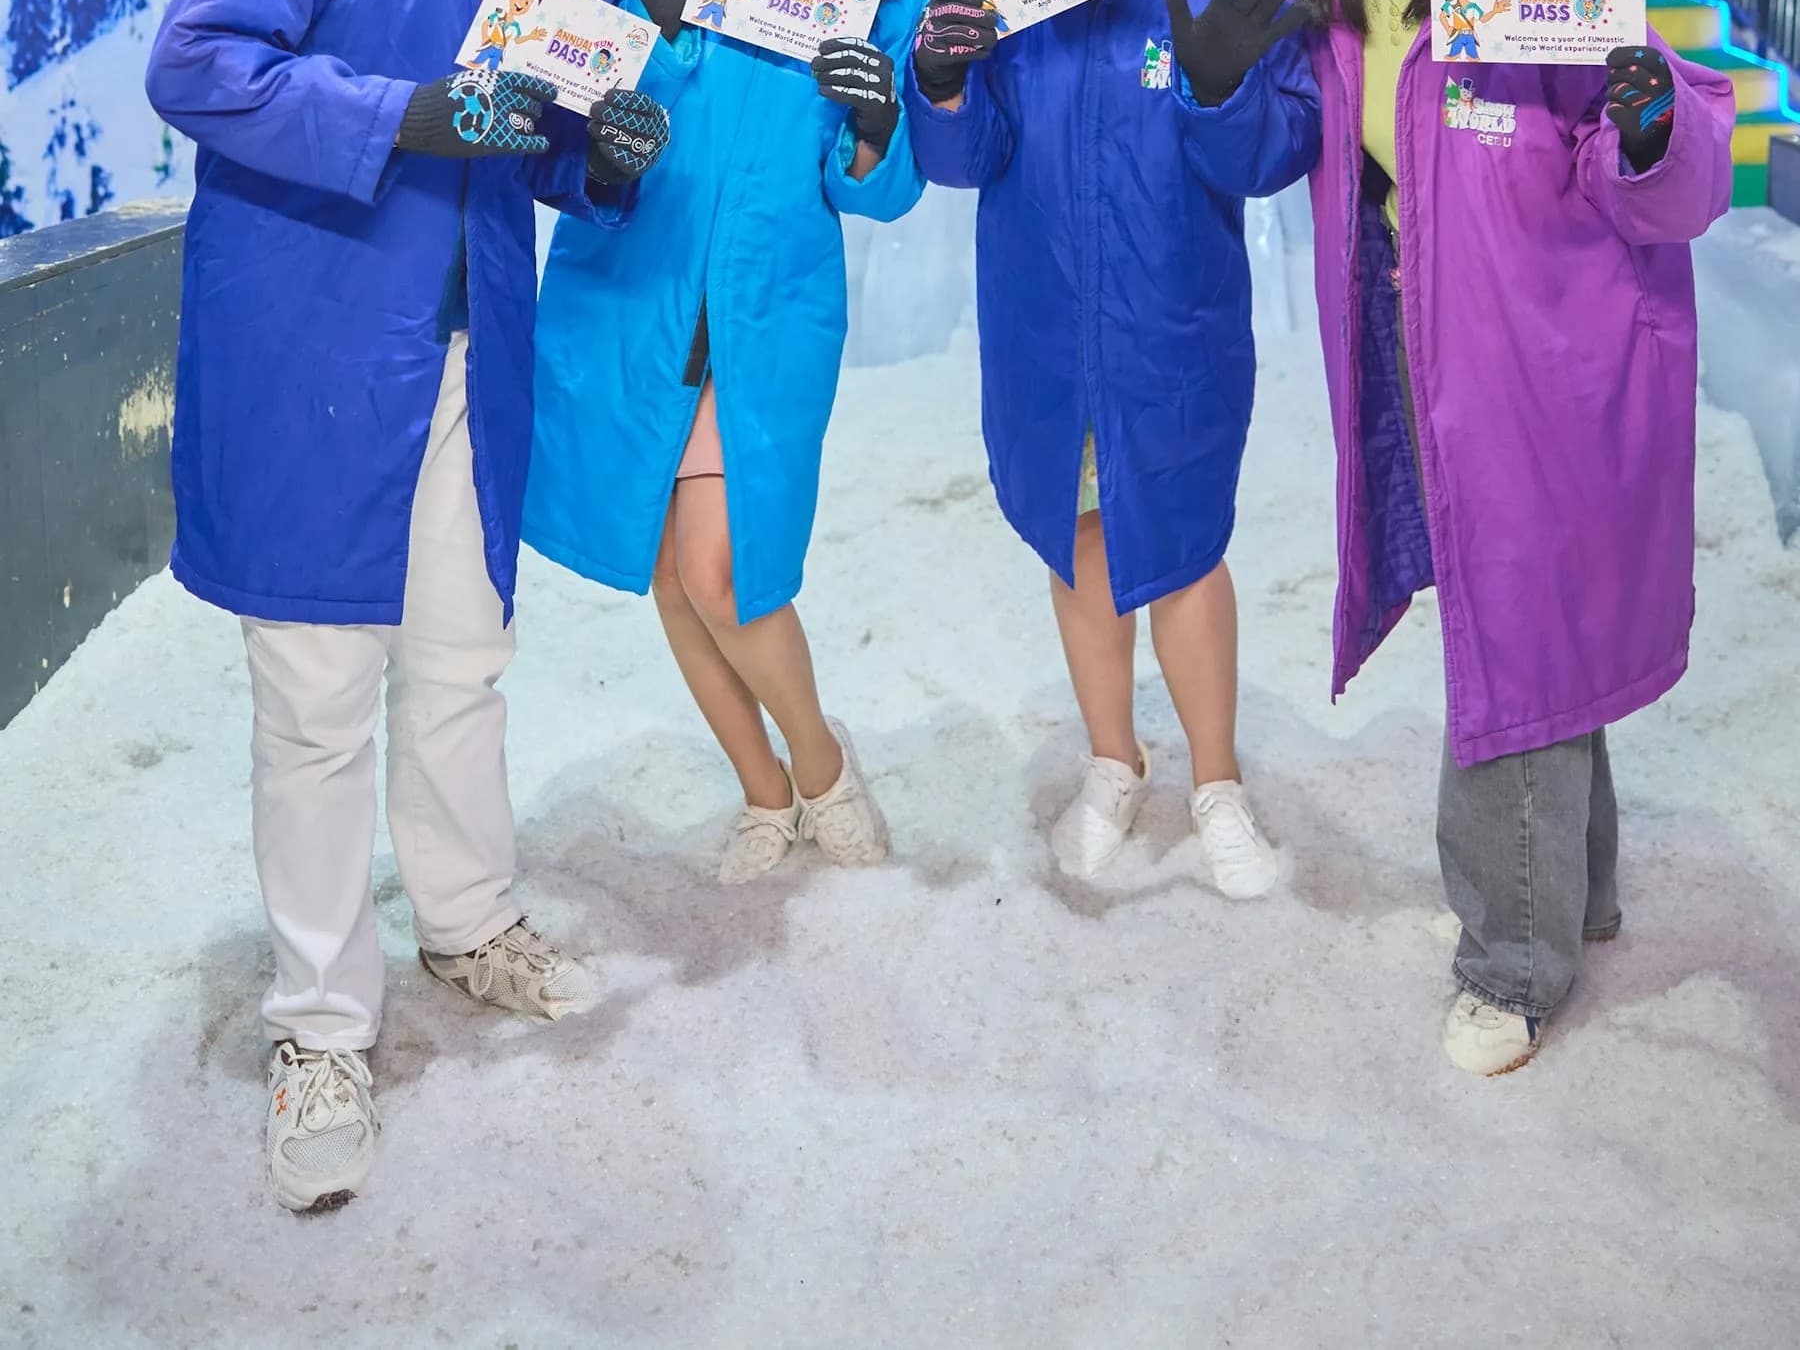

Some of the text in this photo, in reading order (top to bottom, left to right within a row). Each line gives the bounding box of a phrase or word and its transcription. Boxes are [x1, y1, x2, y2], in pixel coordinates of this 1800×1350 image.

[1038, 0, 1052, 8] Anjo
[1519, 3, 1571, 22] PASS
[749, 15, 777, 29] Welcome
[792, 31, 807, 39] year
[555, 28, 594, 53] ANNUAL
[593, 40, 614, 50] FUN
[758, 27, 773, 37] Anjo
[774, 32, 794, 43] World
[794, 39, 817, 51] experie
[1504, 34, 1538, 42] Welcome
[1540, 34, 1549, 42] to
[1558, 36, 1575, 44] year
[1577, 35, 1586, 43] of
[1588, 35, 1625, 43] FUNtastic
[1520, 44, 1537, 52] Anjo
[1564, 44, 1609, 53] experience!
[548, 39, 589, 69] PASS
[526, 61, 552, 77] Welcome
[566, 79, 580, 88] year
[567, 90, 596, 103] experienc
